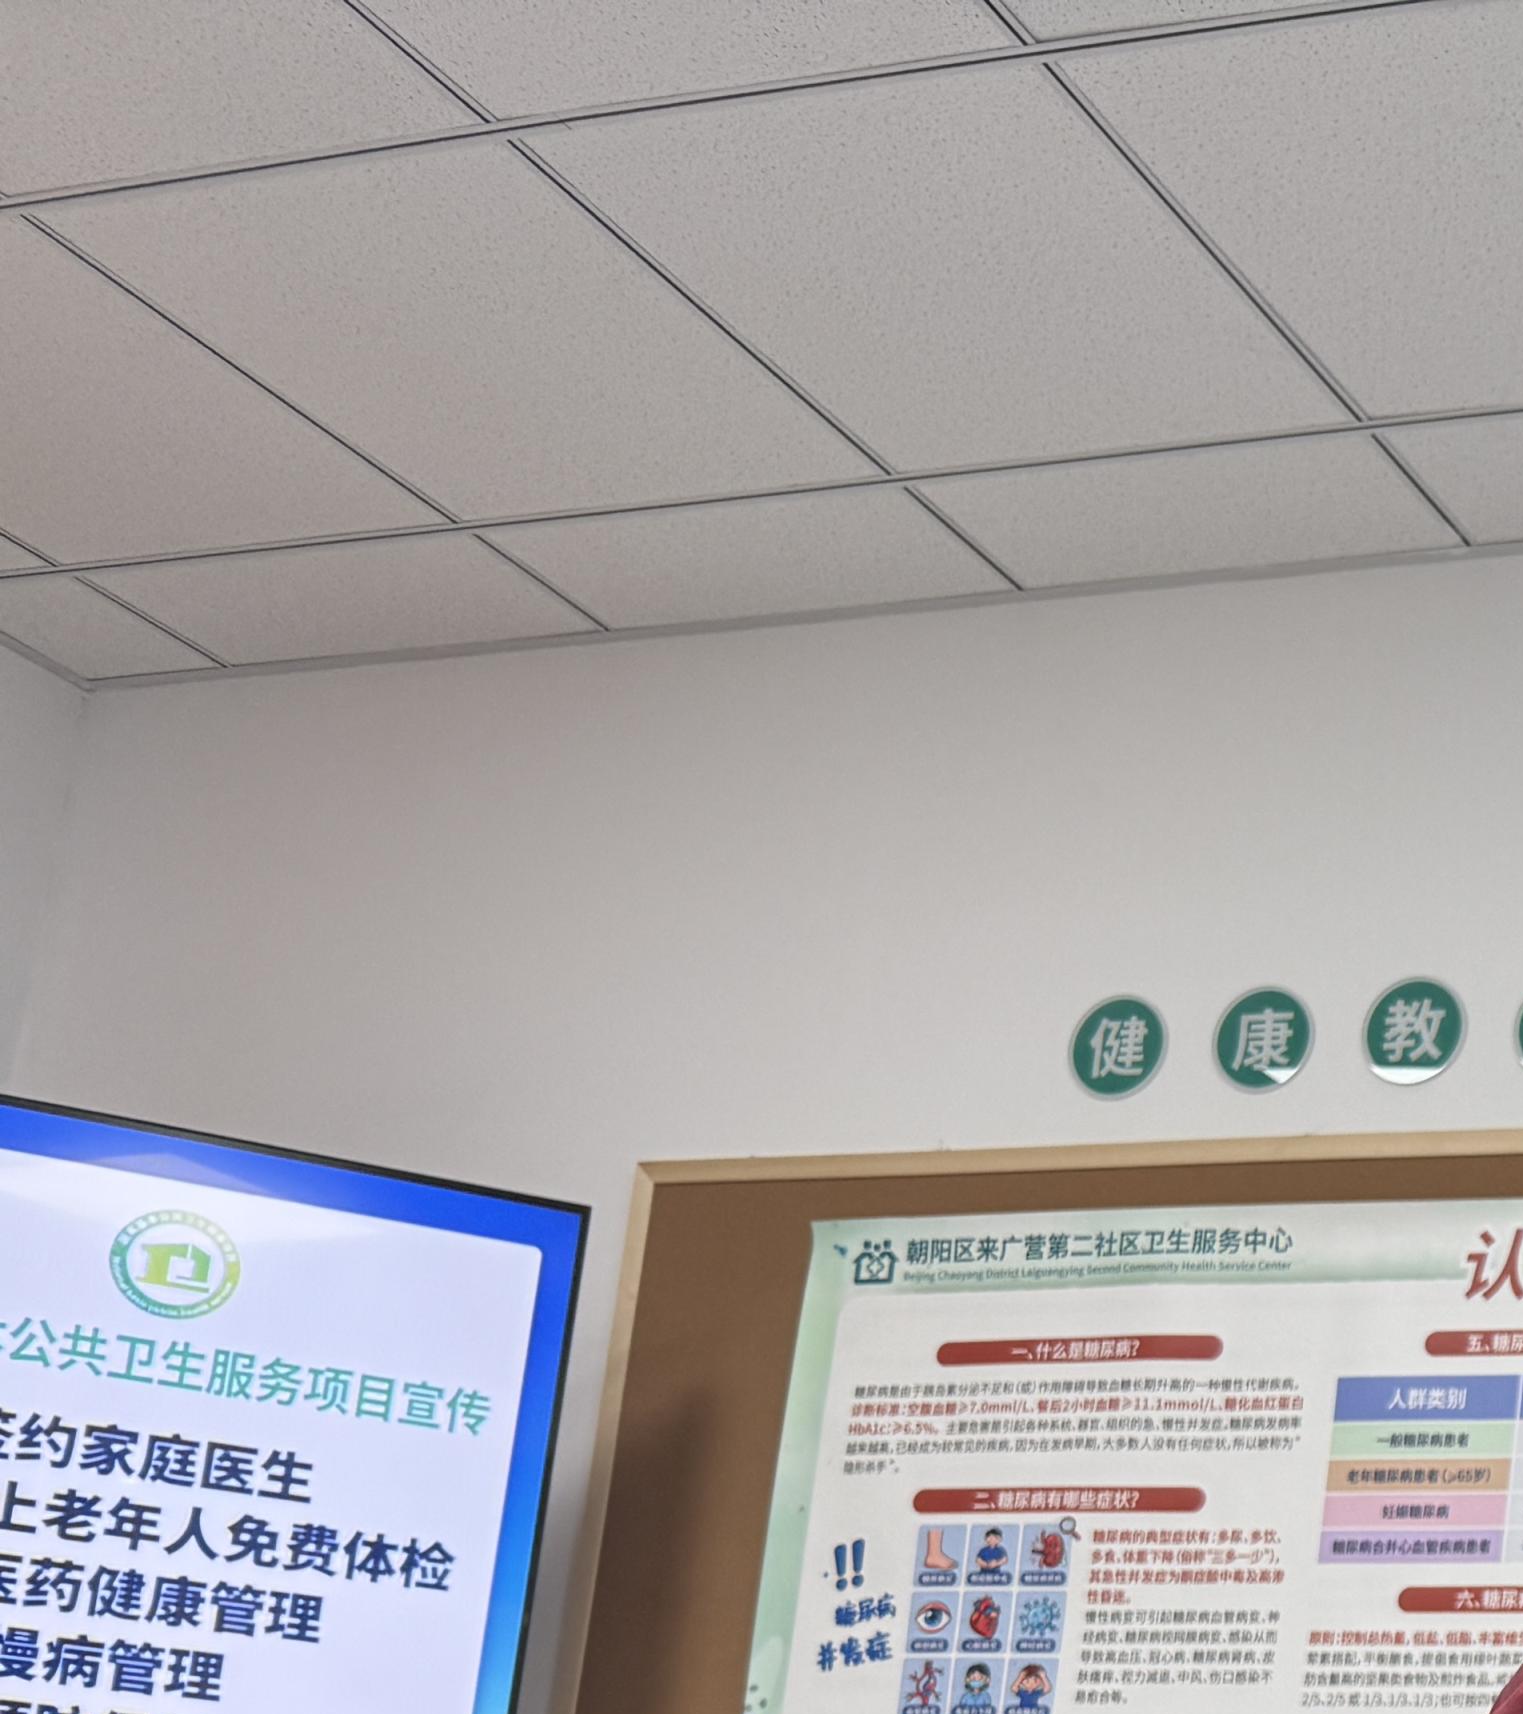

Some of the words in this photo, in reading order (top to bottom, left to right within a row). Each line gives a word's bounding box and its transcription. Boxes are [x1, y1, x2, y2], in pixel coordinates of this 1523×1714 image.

[905, 1227, 1293, 1265] 朝阳区来广营第二社区卫生服务中心
[1011, 1339, 1140, 1359] 一、什么是糖尿病？
[0, 1316, 490, 1436] 公共卫生服务项目宣传
[1388, 1387, 1467, 1410] 人群类别
[1376, 1432, 1470, 1449] 一般糖尿病患者
[972, 1490, 1140, 1510] 二、糖尿病有哪些症状？
